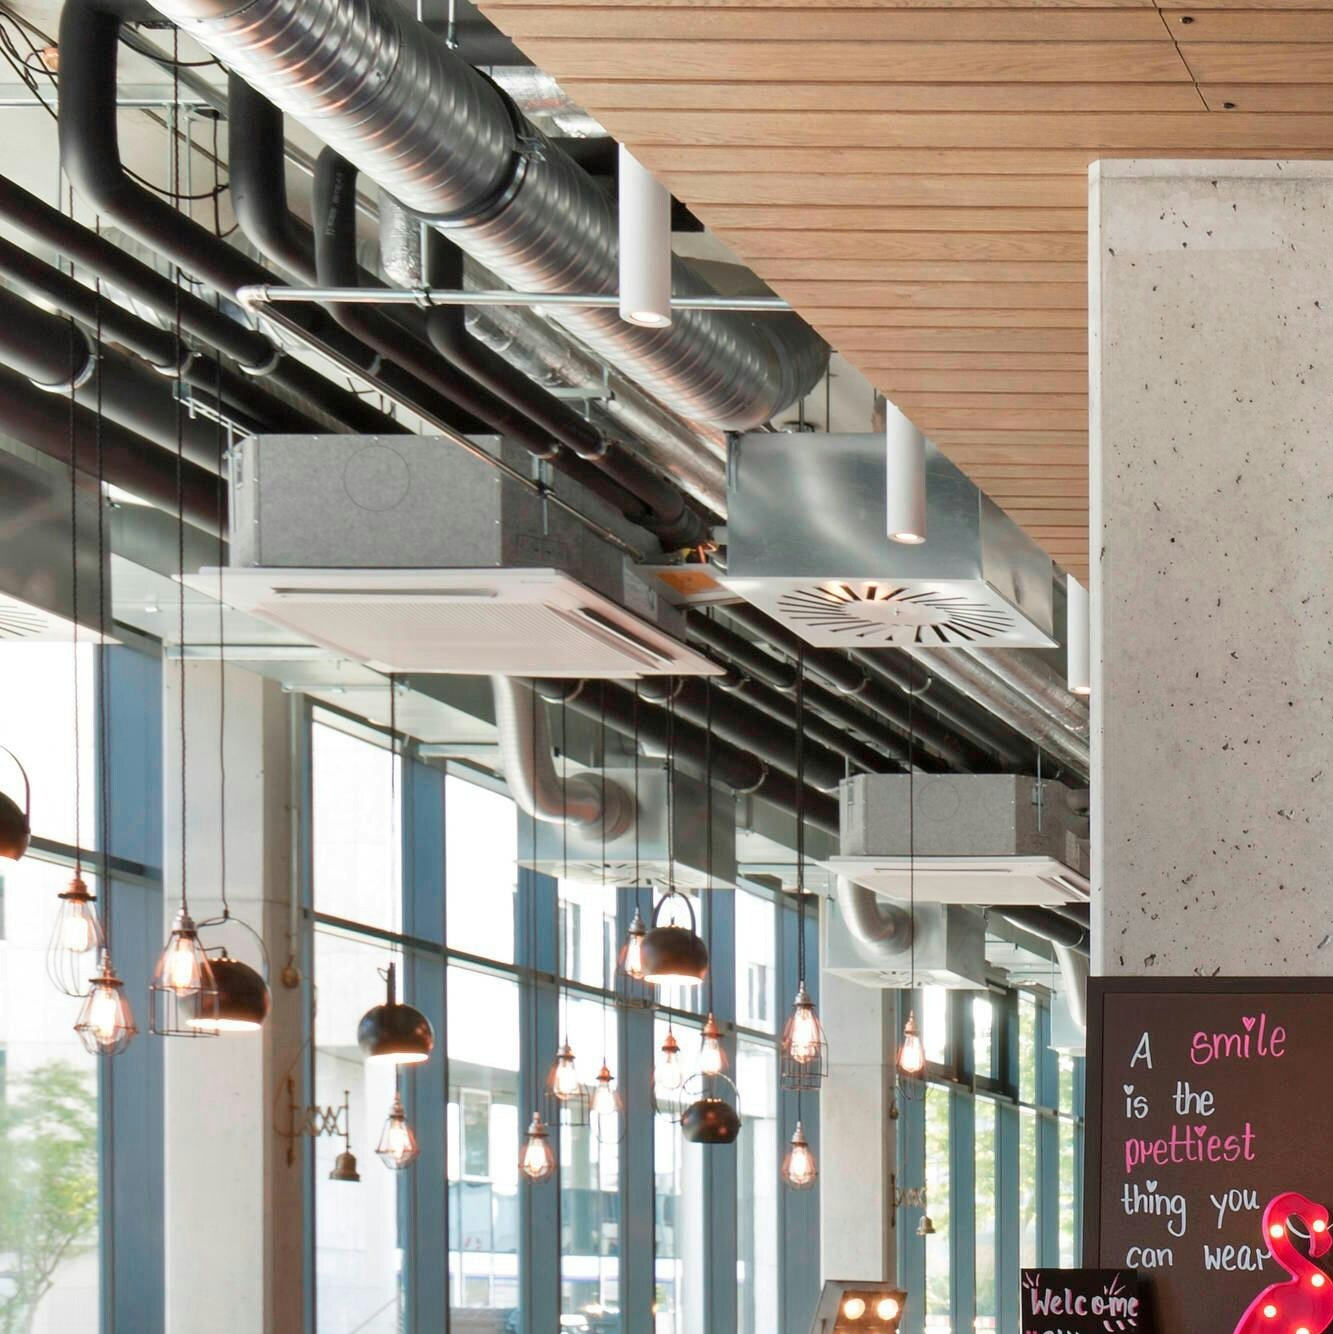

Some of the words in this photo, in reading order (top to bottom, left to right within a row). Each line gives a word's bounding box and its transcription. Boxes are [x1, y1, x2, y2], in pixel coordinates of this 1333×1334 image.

[1130, 1032, 1153, 1069] A
[1190, 1013, 1287, 1066] smile
[1123, 1084, 1149, 1119] is
[1172, 1081, 1215, 1116] the
[1125, 1122, 1256, 1173] prettiest
[1121, 1179, 1186, 1237] thing
[1210, 1189, 1260, 1228] you
[1126, 1244, 1174, 1269] can
[1203, 1242, 1272, 1271] wear
[1030, 1287, 1139, 1318] Welcome
